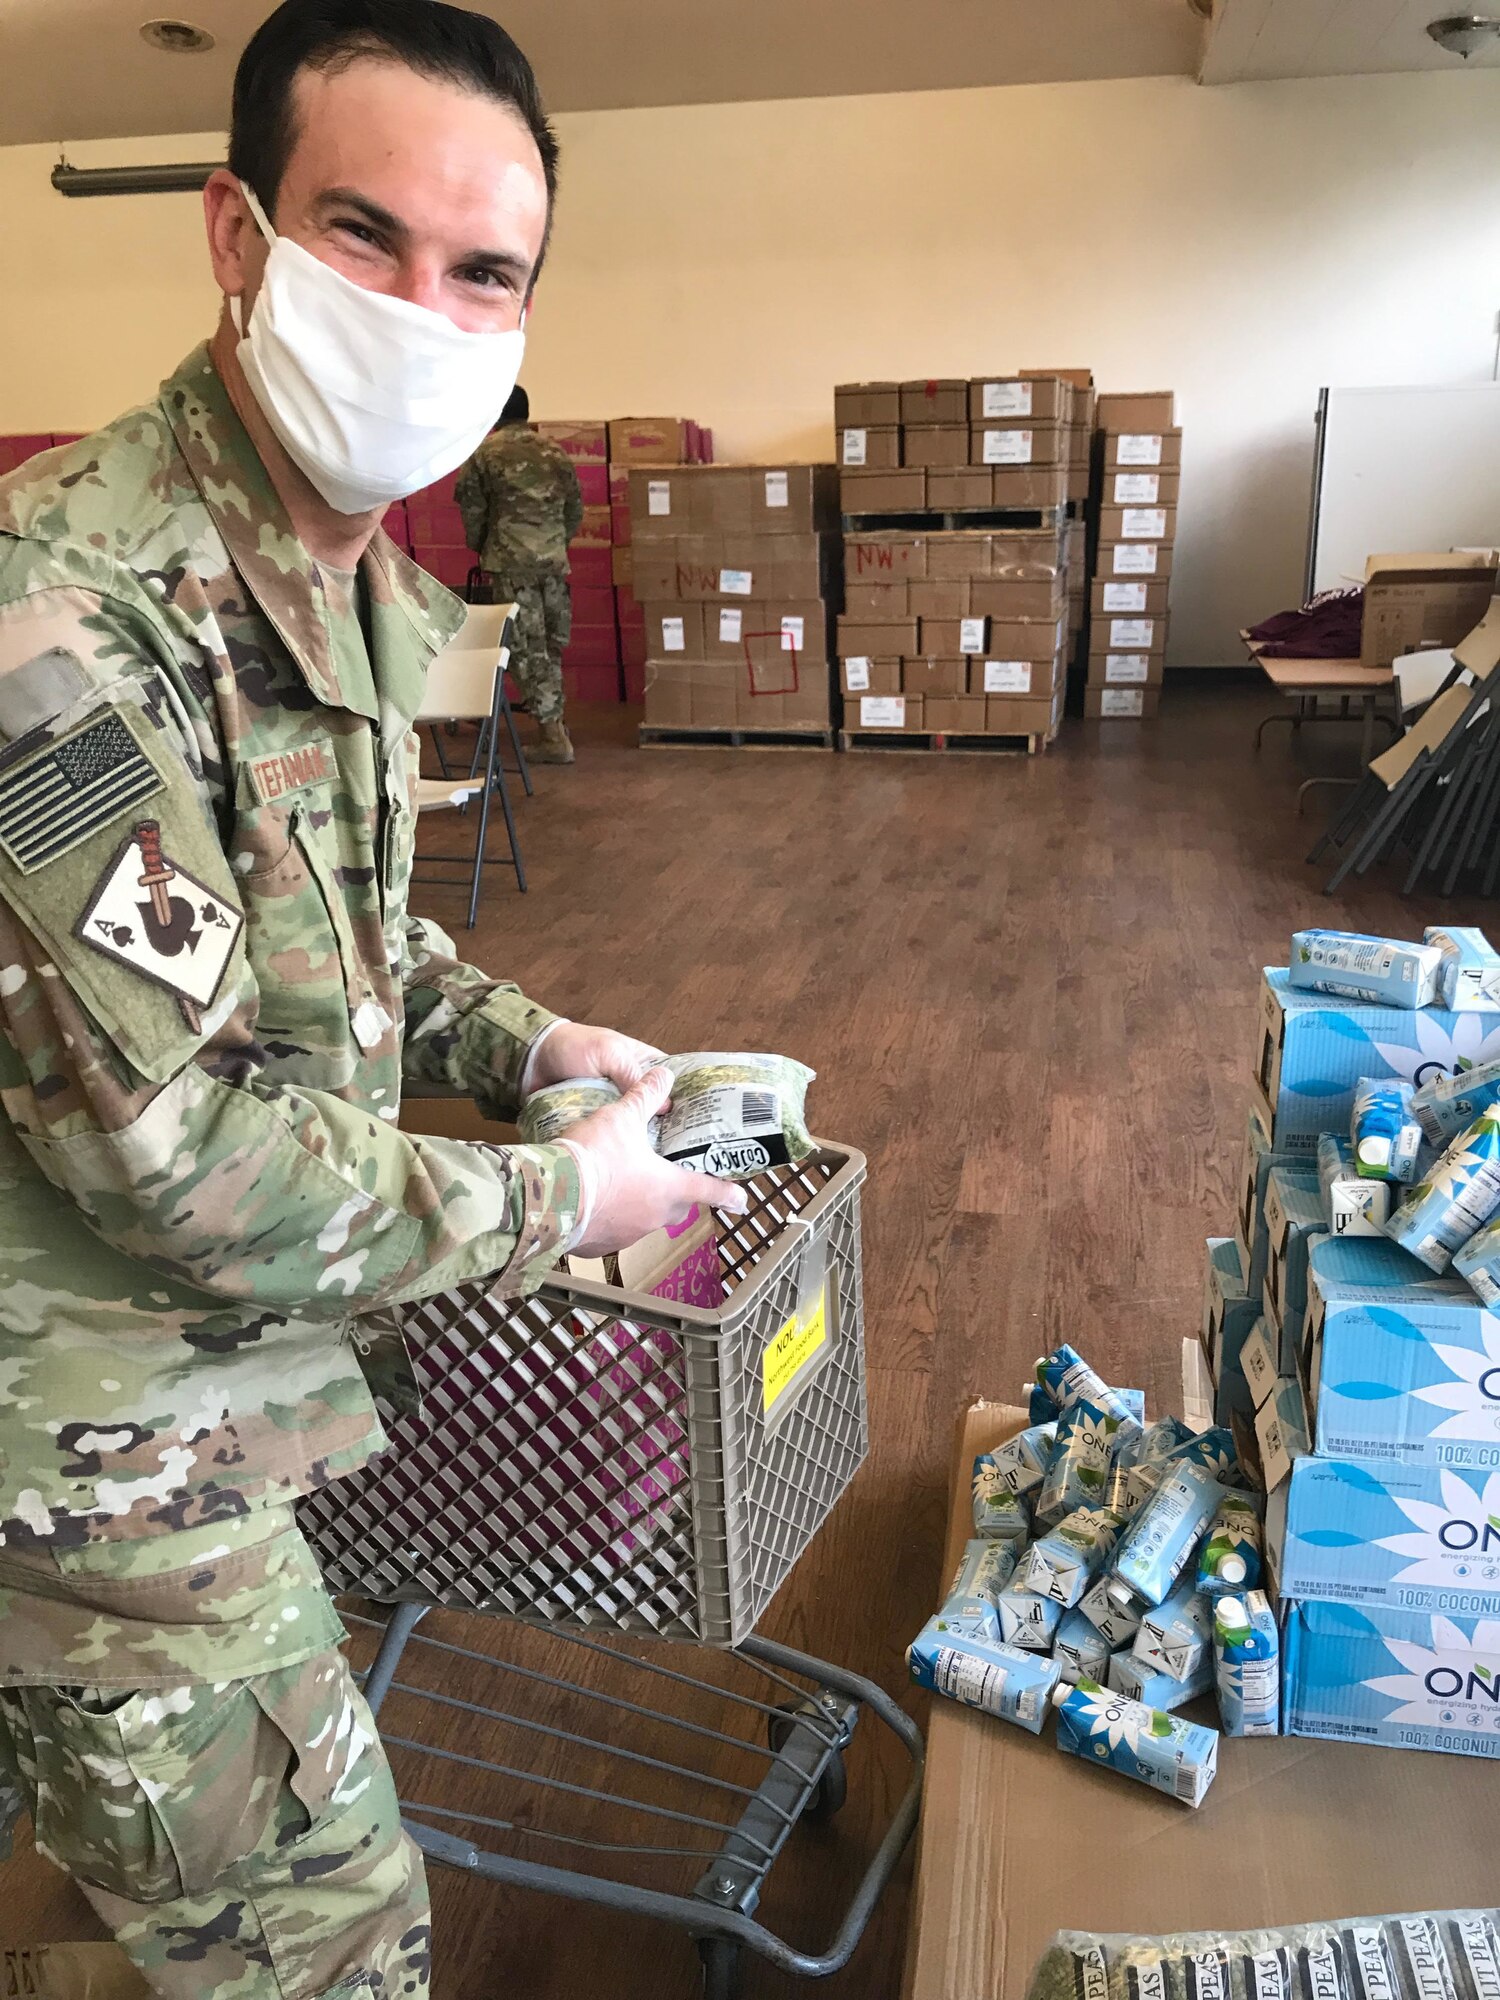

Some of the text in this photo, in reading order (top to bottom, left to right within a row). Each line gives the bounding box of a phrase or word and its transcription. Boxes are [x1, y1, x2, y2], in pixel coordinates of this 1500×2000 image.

[856, 543, 893, 575] NW
[675, 562, 717, 598] NW
[94, 919, 116, 938] A
[215, 911, 231, 930] A
[1400, 1159, 1412, 1179] ONE
[1081, 1432, 1112, 1457] ONE
[1437, 1445, 1473, 1464] 100%
[1073, 1512, 1109, 1534] ONE
[1215, 1518, 1256, 1537] ONE
[1440, 1552, 1493, 1563] energizing
[1399, 1589, 1433, 1608] 100%
[1260, 1615, 1273, 1632] ONE
[1105, 1694, 1132, 1722] ONE
[1427, 1698, 1477, 1710] energizing
[1399, 1731, 1498, 1755] 100% COCONUT
[1406, 1922, 1435, 1969] PEAS
[1466, 1919, 1493, 1961] PEAS
[1360, 1935, 1386, 1988] PEAS
[1084, 1950, 1106, 2000] PEAS
[1197, 1952, 1221, 2000] PEAS
[1262, 1960, 1281, 2000] EAS
